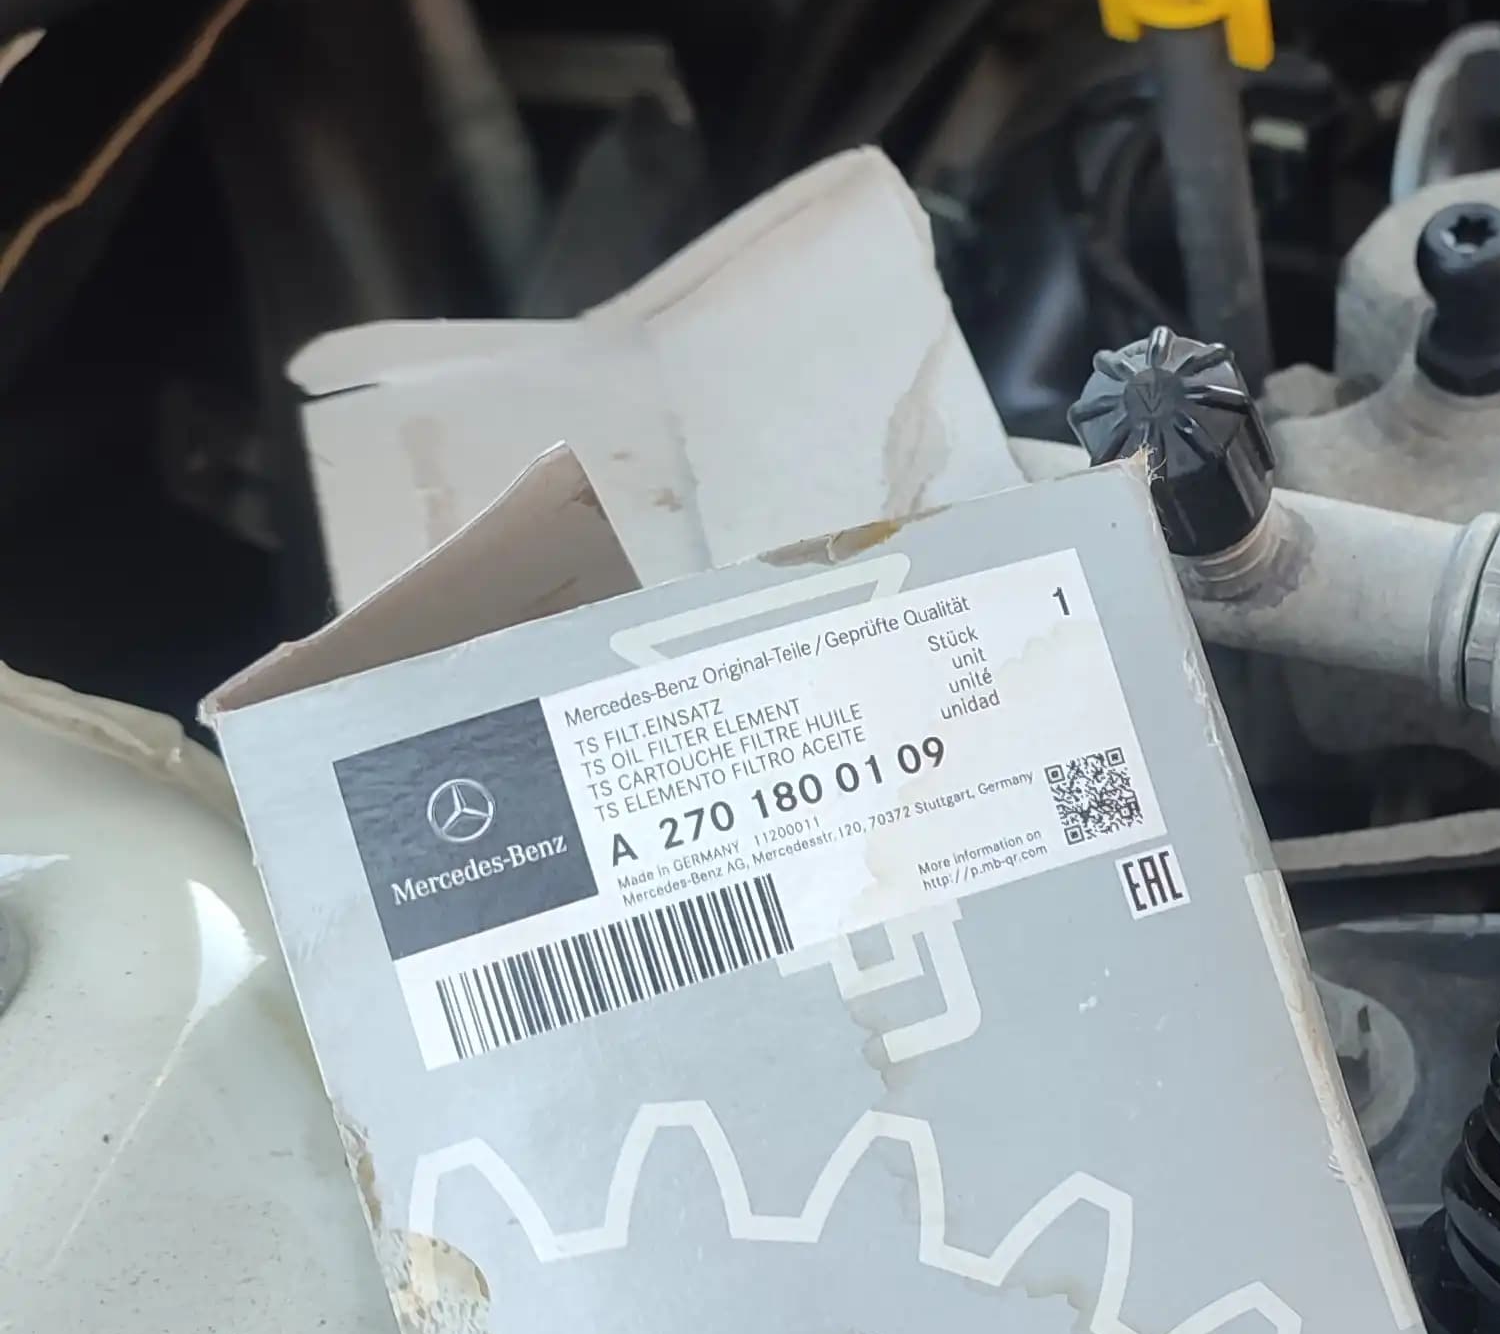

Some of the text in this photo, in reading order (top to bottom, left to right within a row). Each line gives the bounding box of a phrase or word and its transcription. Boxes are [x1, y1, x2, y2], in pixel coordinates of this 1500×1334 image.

[1052, 586, 1070, 616] 1
[564, 676, 699, 727] Mercedes-Benz
[703, 641, 811, 683] Original-Teile
[825, 618, 900, 648] Geprüfte
[904, 596, 971, 626] Qualität
[927, 625, 979, 652] Stück
[952, 647, 987, 669] unit
[940, 689, 1001, 720] unidad
[948, 667, 993, 694] unité
[574, 697, 723, 757] TS FILT.EINSATZ
[580, 697, 801, 779] TS OIL FILTER ELEMENT
[587, 703, 863, 801] TS CARTOUCHE FILTRE HUILE
[594, 725, 866, 822] TS ELEMENTO FILTRO ACEITE
[612, 736, 945, 867] A 270 180 01 09
[391, 834, 568, 906] Mercedes-Benz
[617, 871, 654, 890] Made
[673, 841, 740, 872] GERMANY
[754, 817, 820, 847] 11200011
[623, 866, 723, 908] Mercedes-Benz
[867, 807, 911, 833] 70372
[977, 770, 1034, 796] Germany
[917, 829, 1043, 876] More information on
